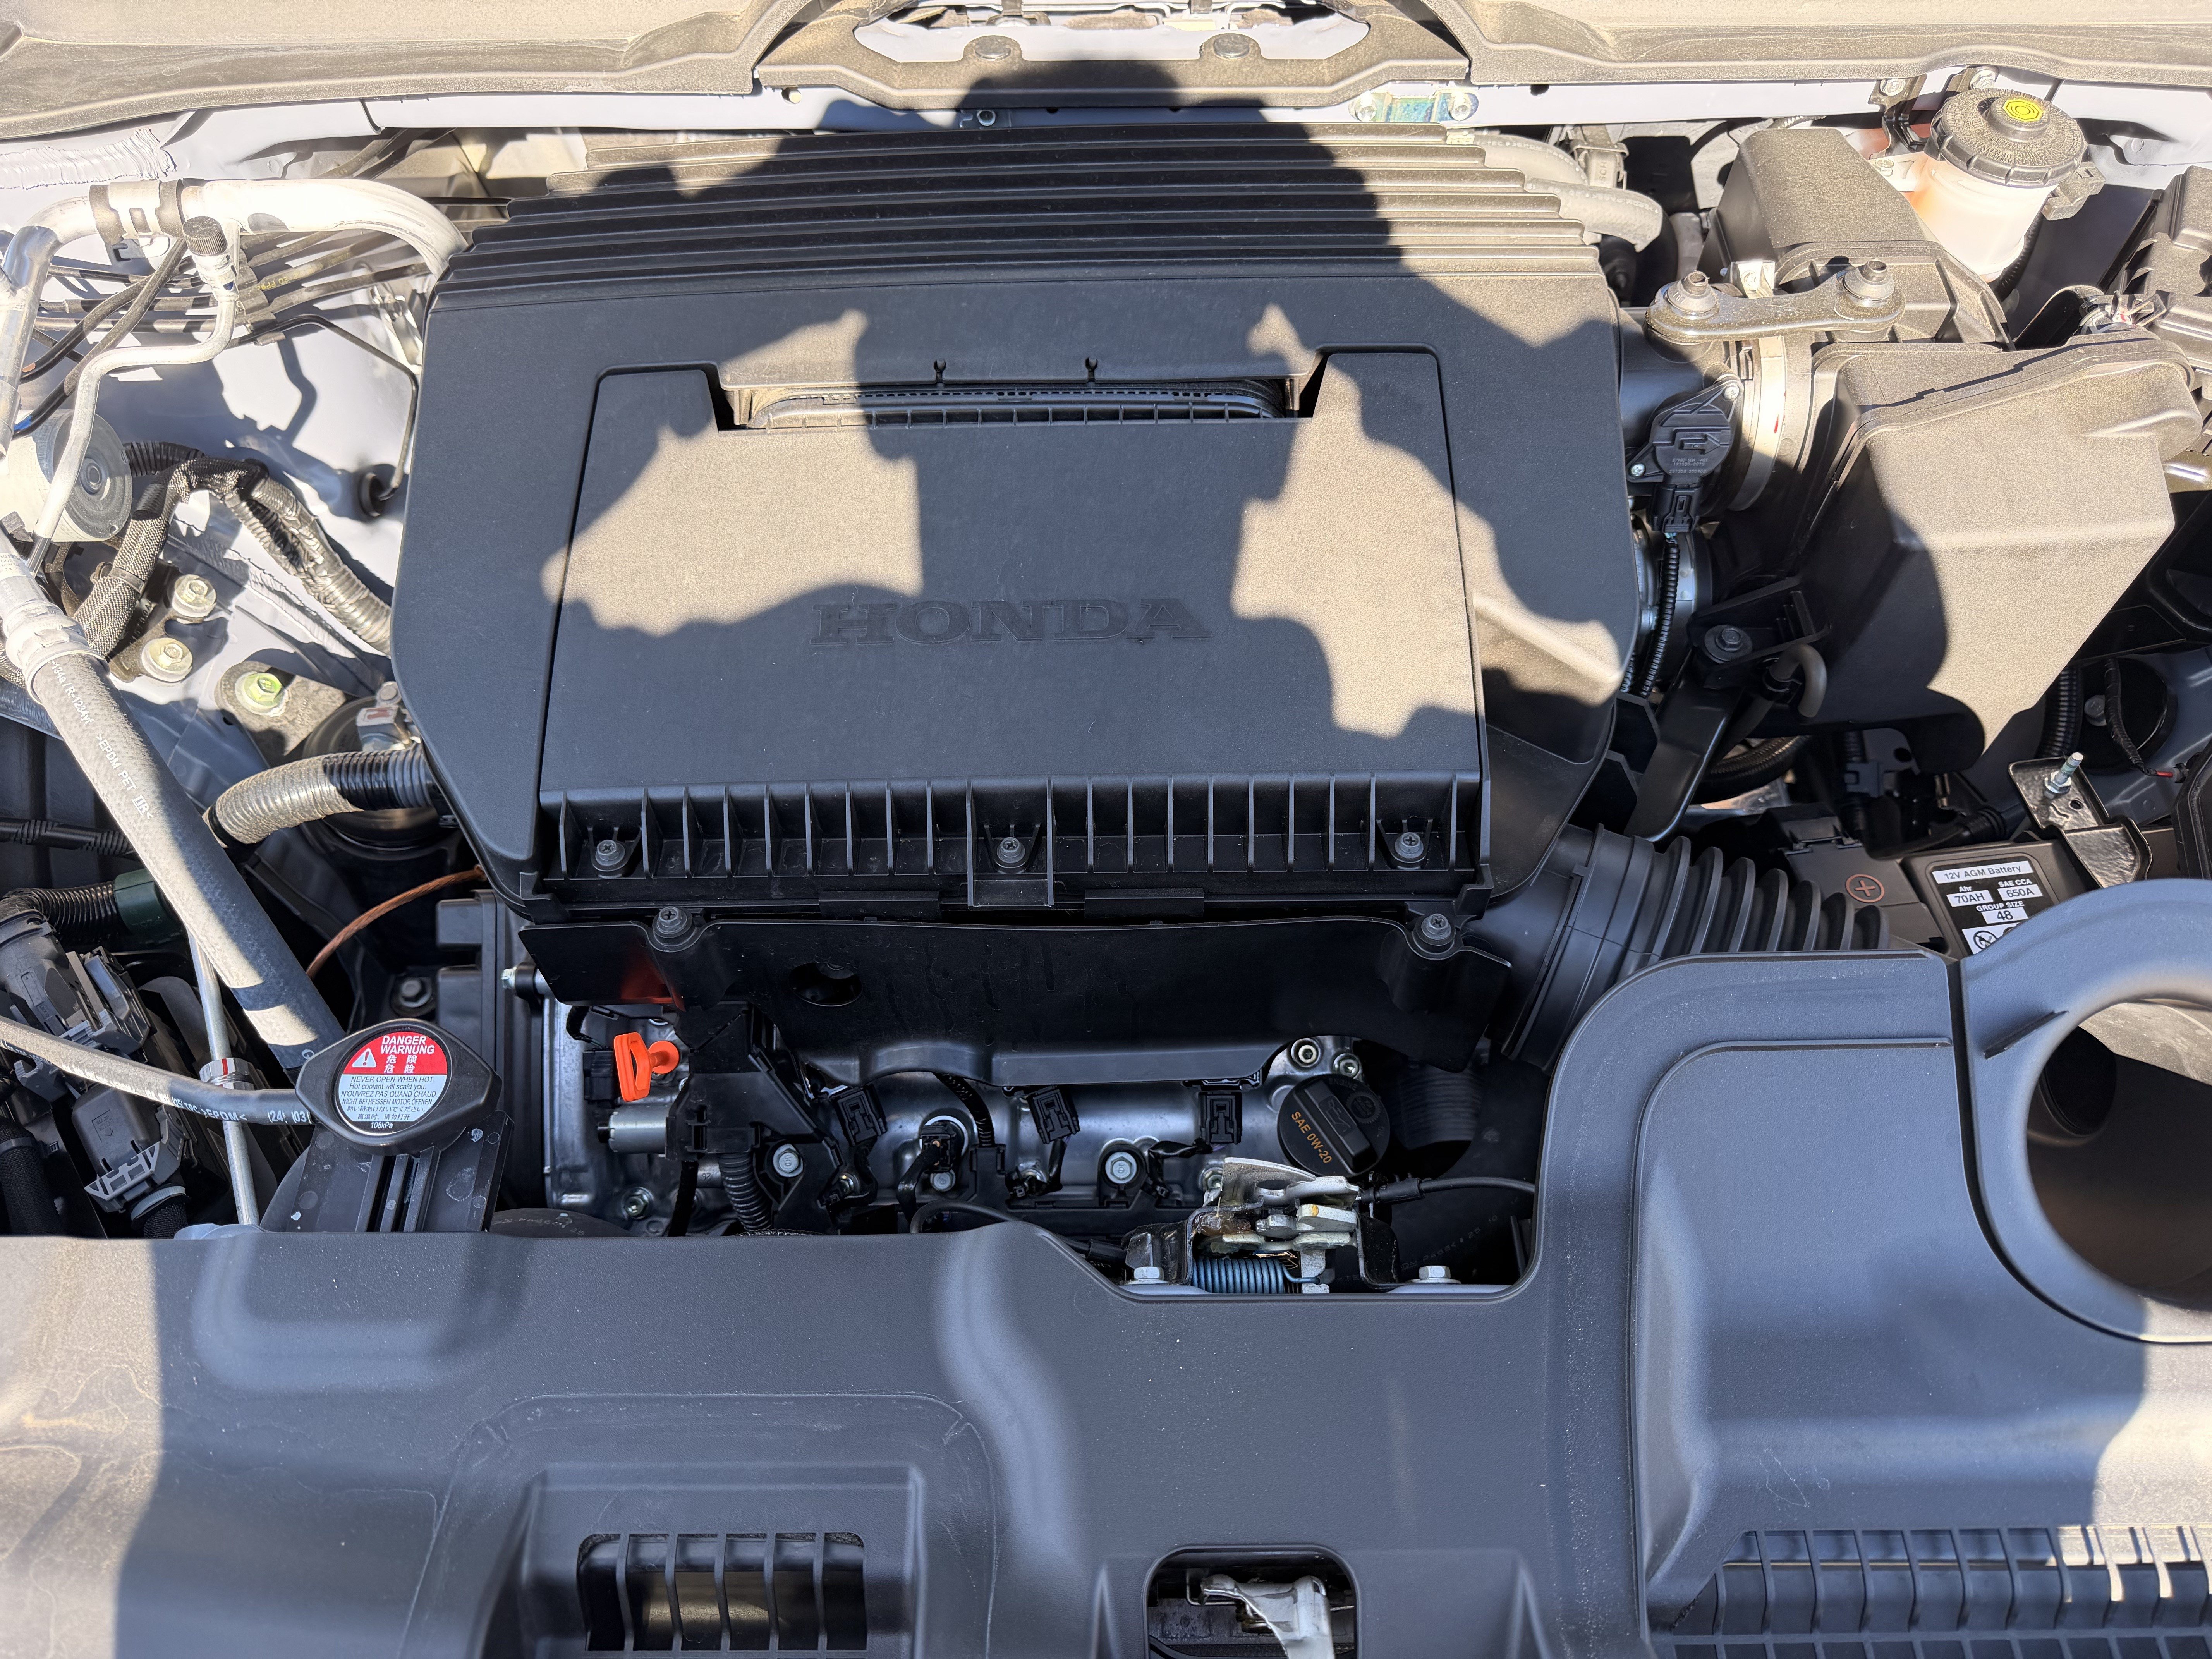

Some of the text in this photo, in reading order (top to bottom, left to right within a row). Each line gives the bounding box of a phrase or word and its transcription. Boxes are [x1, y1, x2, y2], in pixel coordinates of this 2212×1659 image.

[809, 599, 1213, 646] HONDA
[118, 770, 137, 791] PET
[1965, 869, 1986, 878] AGM
[1987, 865, 2021, 874] Battery
[2006, 887, 2035, 898] 650A
[1954, 893, 1985, 904] 70AH
[1976, 903, 2004, 912] GROUP
[1997, 910, 2013, 921] 48
[382, 1036, 427, 1045] DANGER
[380, 1045, 435, 1054] WARNUNG
[1291, 1111, 1332, 1164] SAE 0W-20
